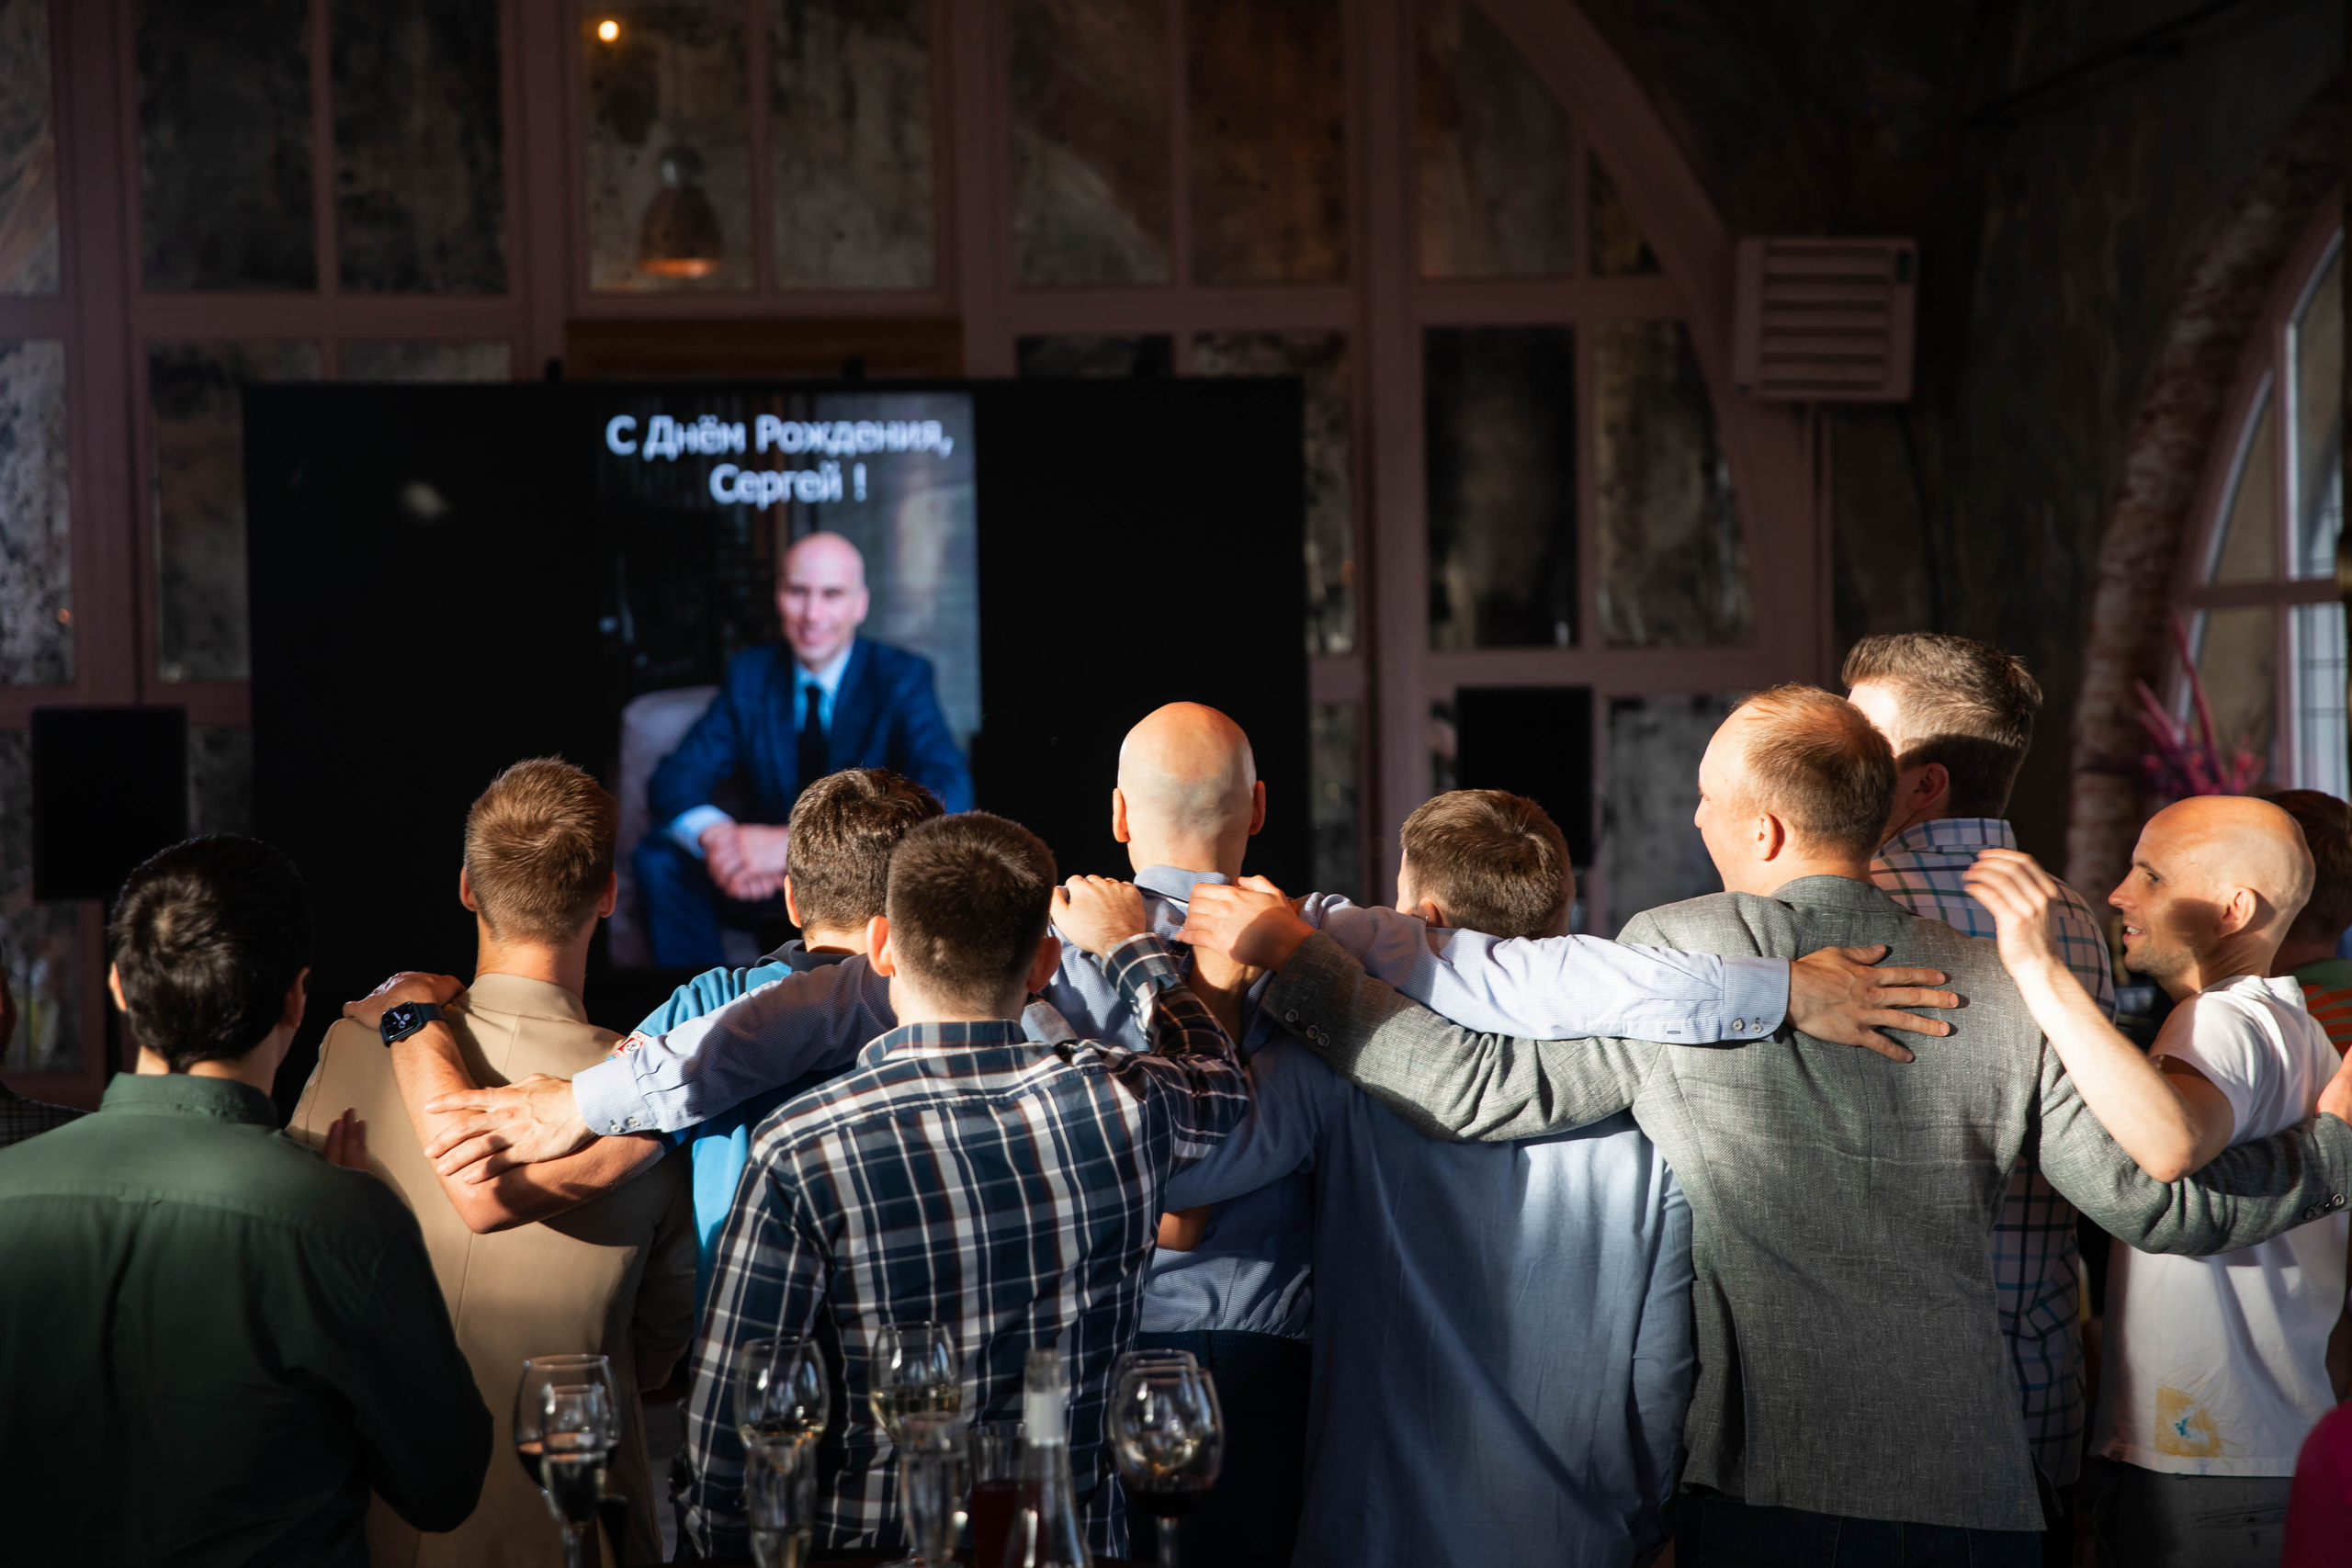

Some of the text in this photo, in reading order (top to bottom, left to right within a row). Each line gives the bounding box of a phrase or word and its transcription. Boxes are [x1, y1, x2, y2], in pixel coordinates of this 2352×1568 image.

[605, 414, 954, 460] С Днём Рождения,
[709, 462, 844, 511] Сергей
